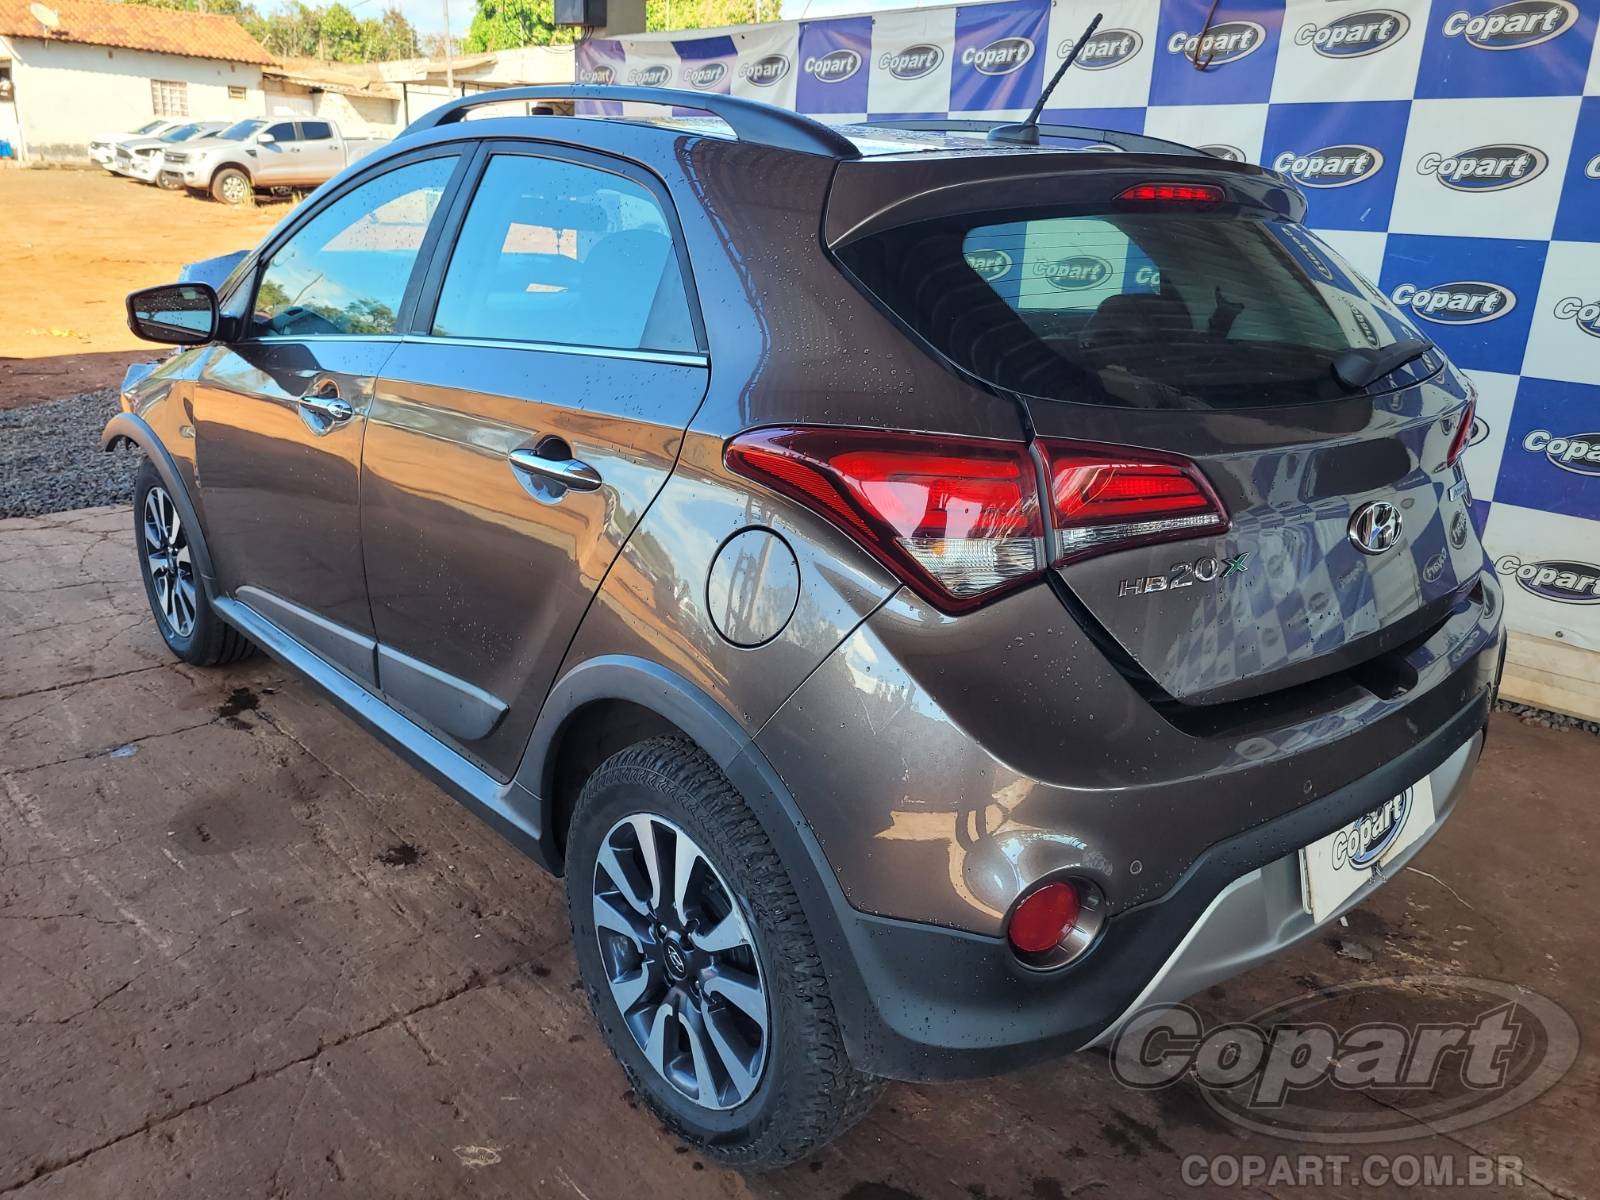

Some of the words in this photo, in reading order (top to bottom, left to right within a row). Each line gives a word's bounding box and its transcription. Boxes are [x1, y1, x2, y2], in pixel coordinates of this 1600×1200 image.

[1295, 16, 1396, 50] Copart
[1443, 5, 1562, 41] Copart
[962, 43, 1027, 69] Copart
[1057, 35, 1131, 63] Cpart
[1167, 27, 1255, 58] Copart
[684, 65, 722, 83] Copart
[739, 60, 784, 80] Copart
[804, 54, 855, 76] Copart
[879, 49, 937, 73] Copart
[580, 68, 610, 83] Copart
[628, 68, 666, 84] Copart
[1273, 150, 1372, 179] Copart
[1416, 151, 1531, 181] Copart
[1033, 259, 1101, 280] Copart
[1391, 283, 1501, 315] Copart
[1522, 430, 1600, 463] Copa
[1118, 552, 1250, 597] HB20X
[1332, 793, 1402, 871] Copart
